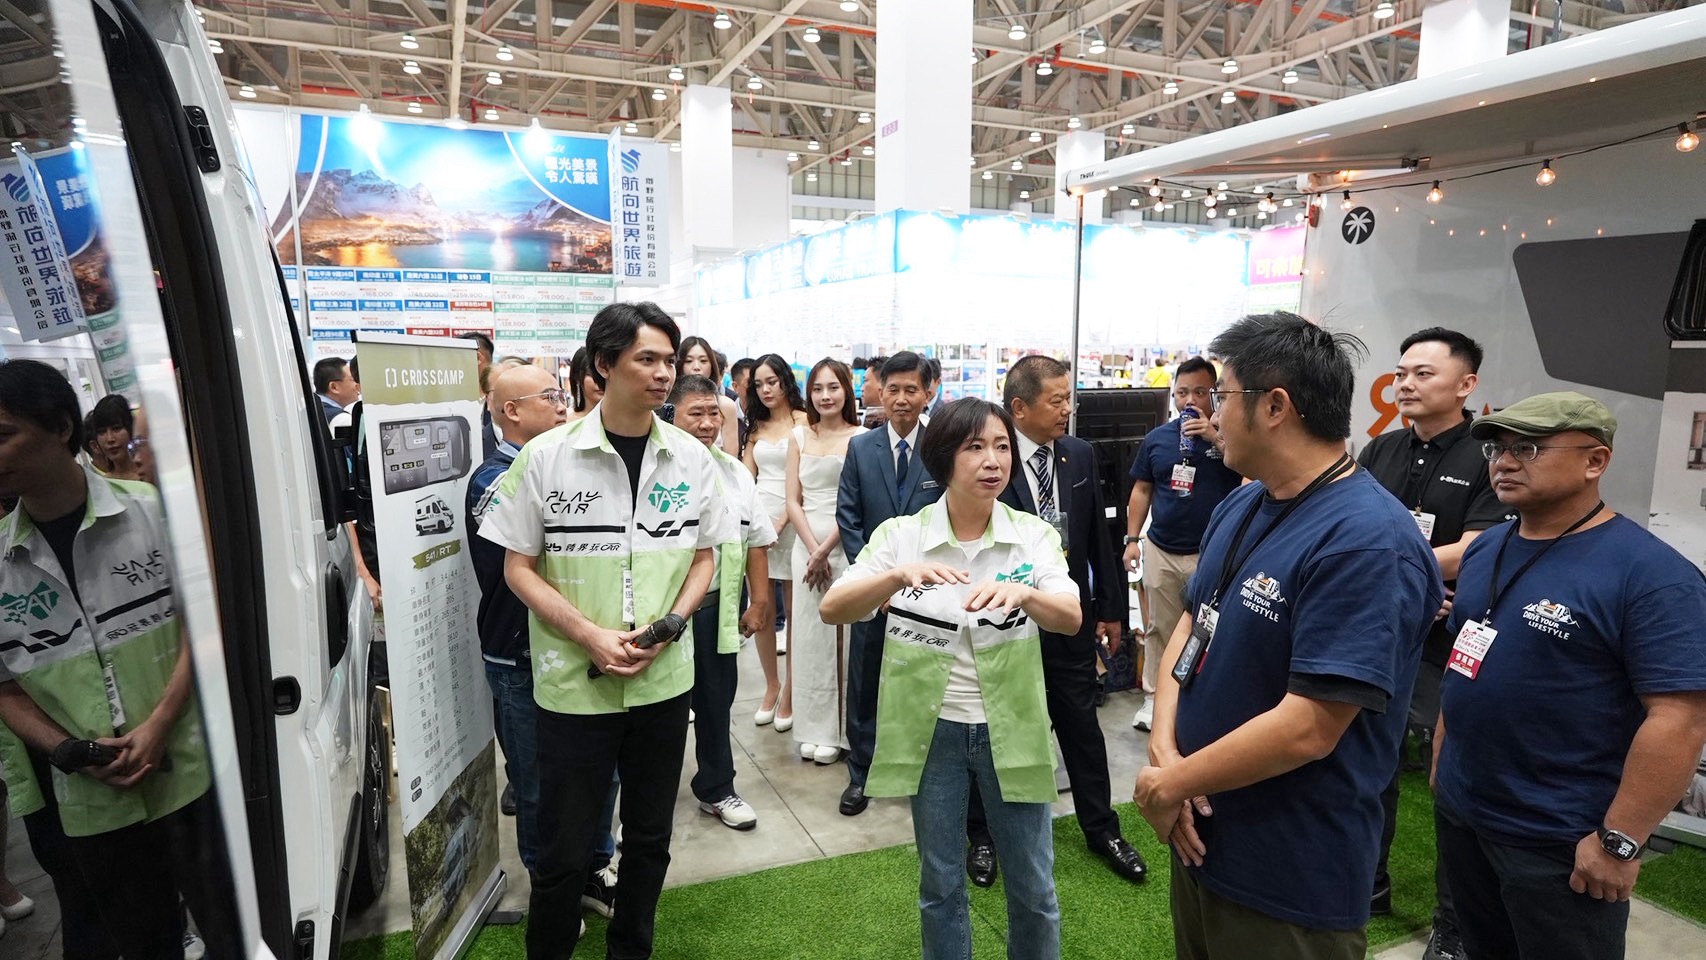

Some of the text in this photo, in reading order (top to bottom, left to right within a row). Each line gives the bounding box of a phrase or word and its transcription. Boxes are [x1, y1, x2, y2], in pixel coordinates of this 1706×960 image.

[622, 176, 642, 277] 航向世界旅遊
[401, 369, 464, 386] CROSSCAMP
[1240, 586, 1272, 608] DRIVE YOUR
[1242, 598, 1280, 623] LIFESTYLE
[1522, 610, 1560, 629] DRIVE YOUR
[888, 626, 950, 648] 跨界玩CAR
[1528, 620, 1570, 640] LIFESTYLE
